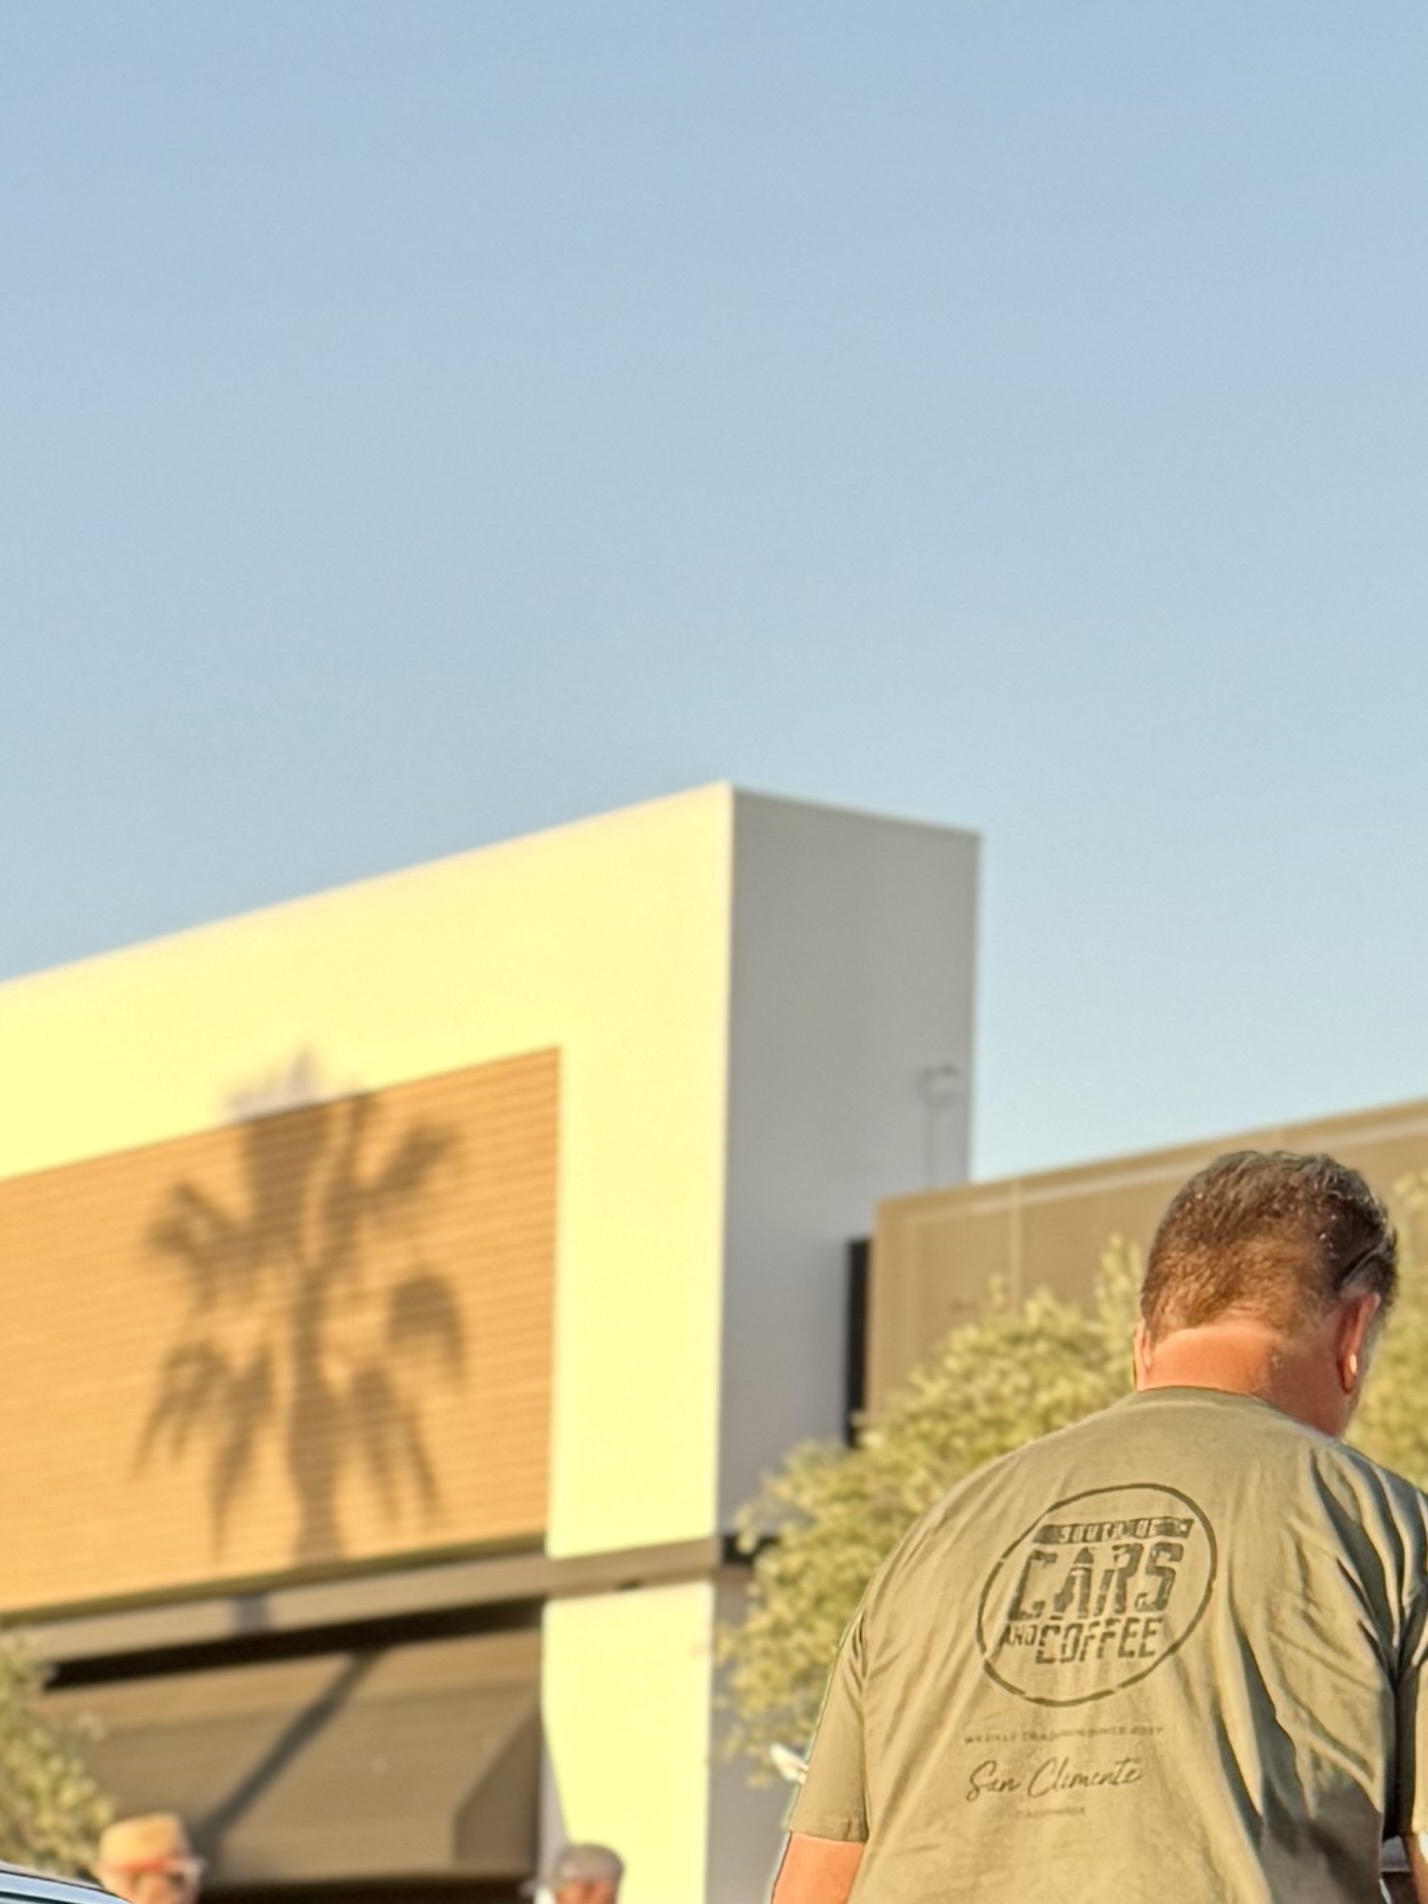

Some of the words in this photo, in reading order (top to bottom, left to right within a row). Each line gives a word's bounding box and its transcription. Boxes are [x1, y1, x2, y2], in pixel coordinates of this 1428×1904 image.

[1008, 1542, 1184, 1621] CARS
[999, 1622, 1038, 1648] AND
[1035, 1617, 1163, 1664] COFFEE
[965, 1759, 1022, 1803] San
[1027, 1756, 1142, 1799] Clemente
